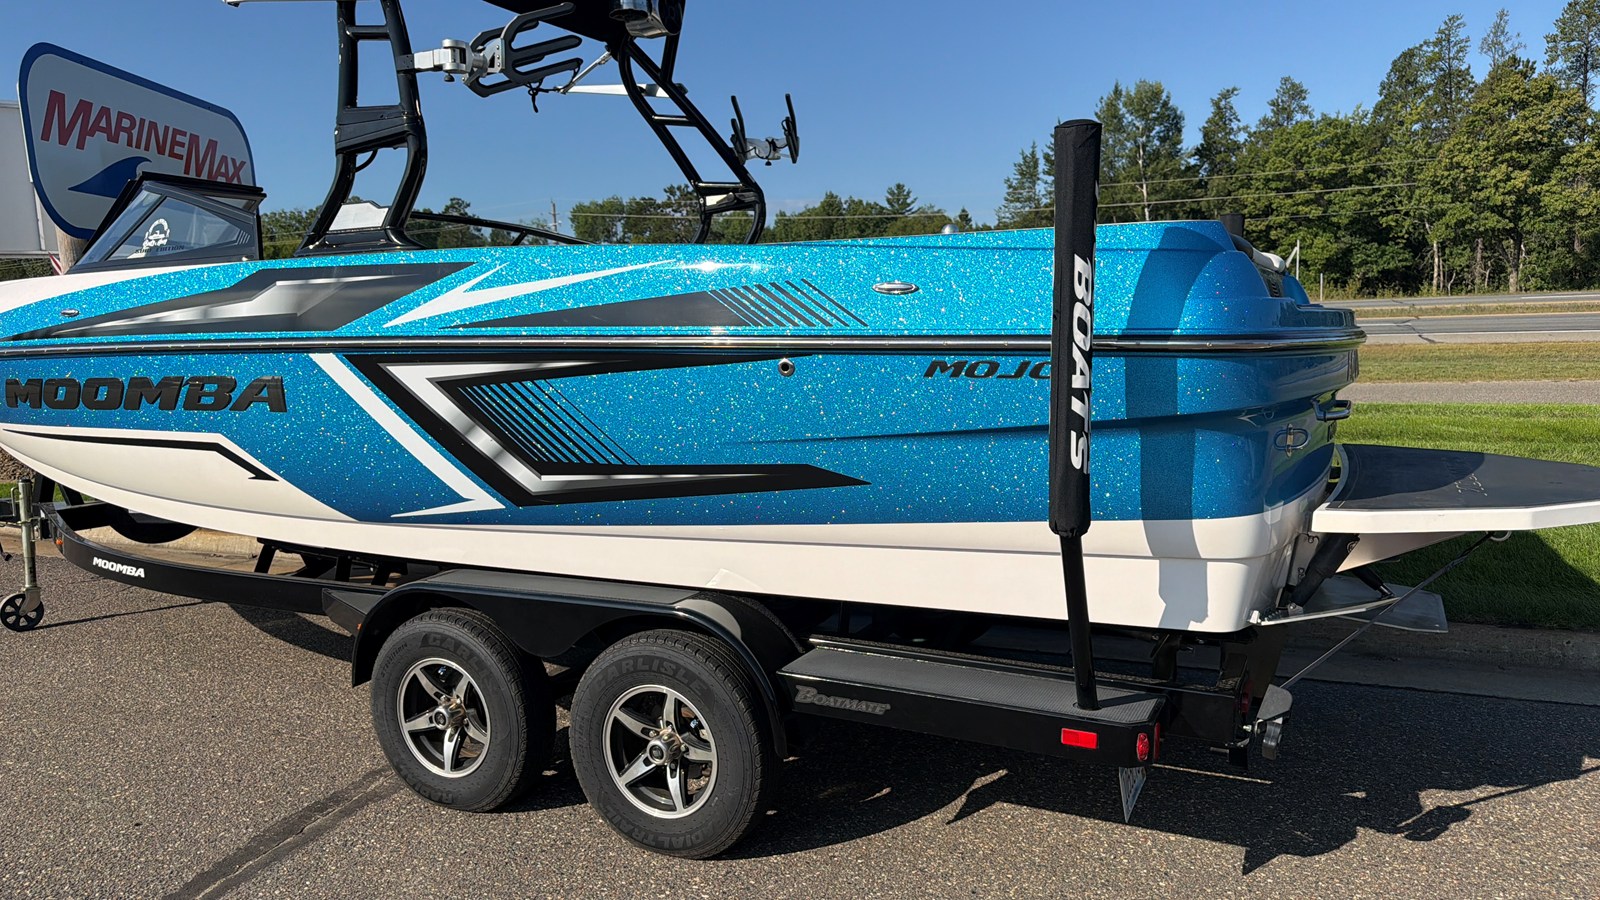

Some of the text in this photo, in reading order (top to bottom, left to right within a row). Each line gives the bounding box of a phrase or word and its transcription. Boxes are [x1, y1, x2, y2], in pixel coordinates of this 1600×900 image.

[1071, 253, 1092, 475] BOATS
[5, 375, 288, 413] MOOMBA
[92, 556, 146, 578] MOOMBA
